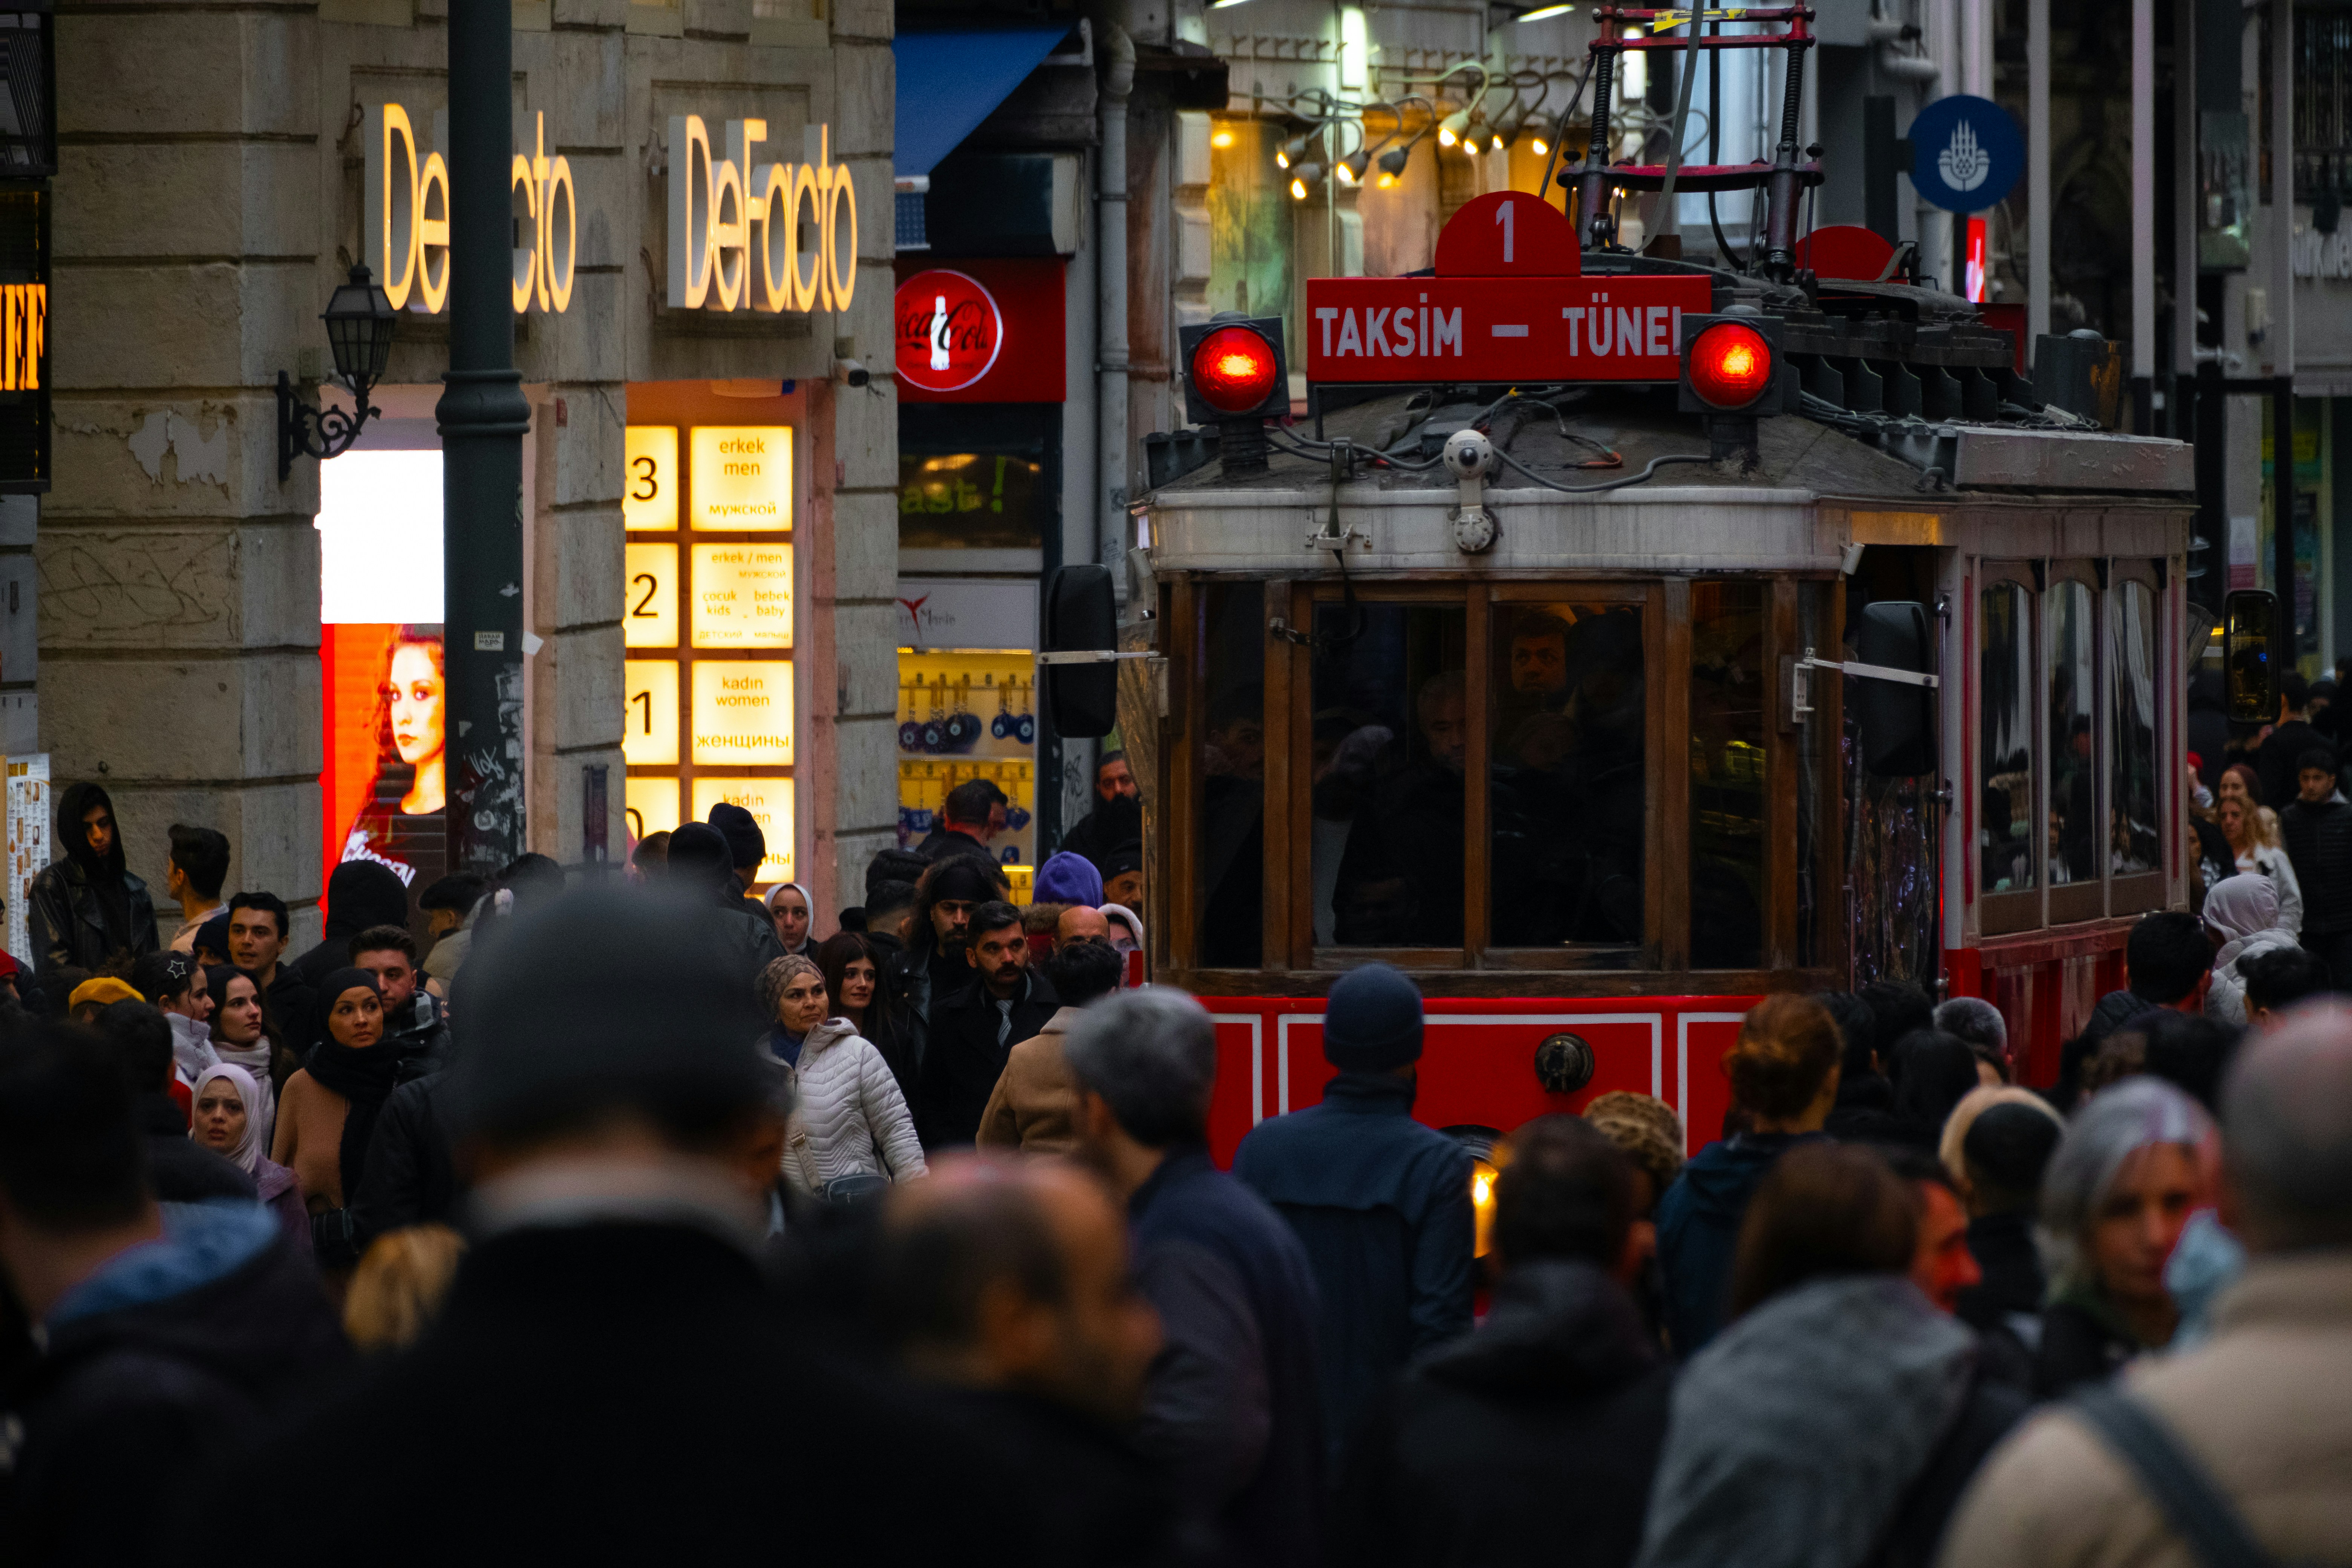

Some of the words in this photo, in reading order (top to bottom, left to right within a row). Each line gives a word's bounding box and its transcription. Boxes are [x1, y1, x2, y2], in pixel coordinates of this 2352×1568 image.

[384, 103, 576, 314] Decto
[685, 114, 858, 313] DeFacto
[1496, 200, 1514, 262] 1
[1315, 292, 1462, 357] TAKSİM
[719, 436, 765, 454] erkek
[724, 462, 760, 476] men
[632, 457, 658, 501] 3
[709, 501, 776, 519] мужской
[711, 551, 744, 564] erkek
[756, 554, 782, 564] men
[632, 573, 658, 618] 2
[754, 591, 790, 602] bebek
[706, 605, 731, 616] kids
[756, 605, 785, 619] baby
[722, 676, 763, 691] kadın
[715, 695, 770, 707] women
[632, 691, 651, 735] 1
[697, 735, 789, 750] женщины
